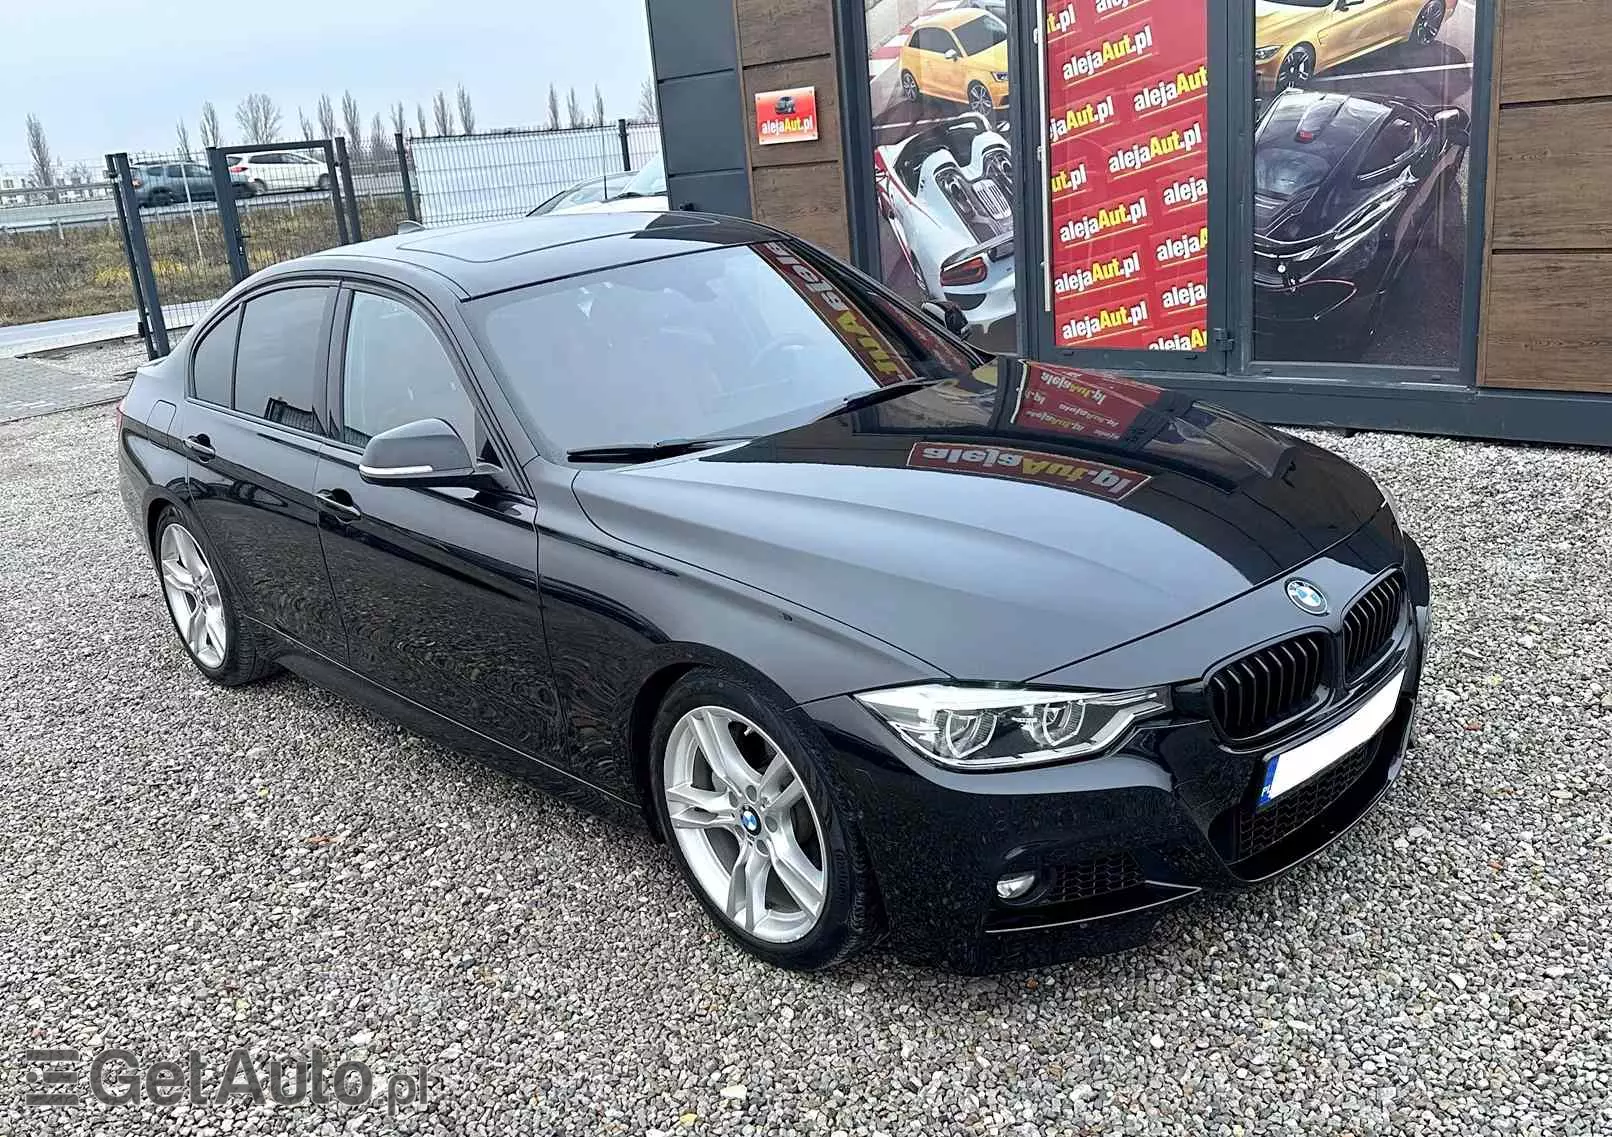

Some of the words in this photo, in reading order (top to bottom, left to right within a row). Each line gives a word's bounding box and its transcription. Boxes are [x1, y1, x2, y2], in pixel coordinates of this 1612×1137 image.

[1063, 25, 1153, 80] alejaAut.pl
[761, 115, 814, 136] alejaAut.pl
[1108, 122, 1202, 173] alejaAut.pl
[1163, 176, 1208, 206] aleja
[1060, 197, 1148, 242] alejaAut.pl
[1054, 251, 1140, 294] alejaAut.pl
[1062, 300, 1148, 339] alejaAut.pl
